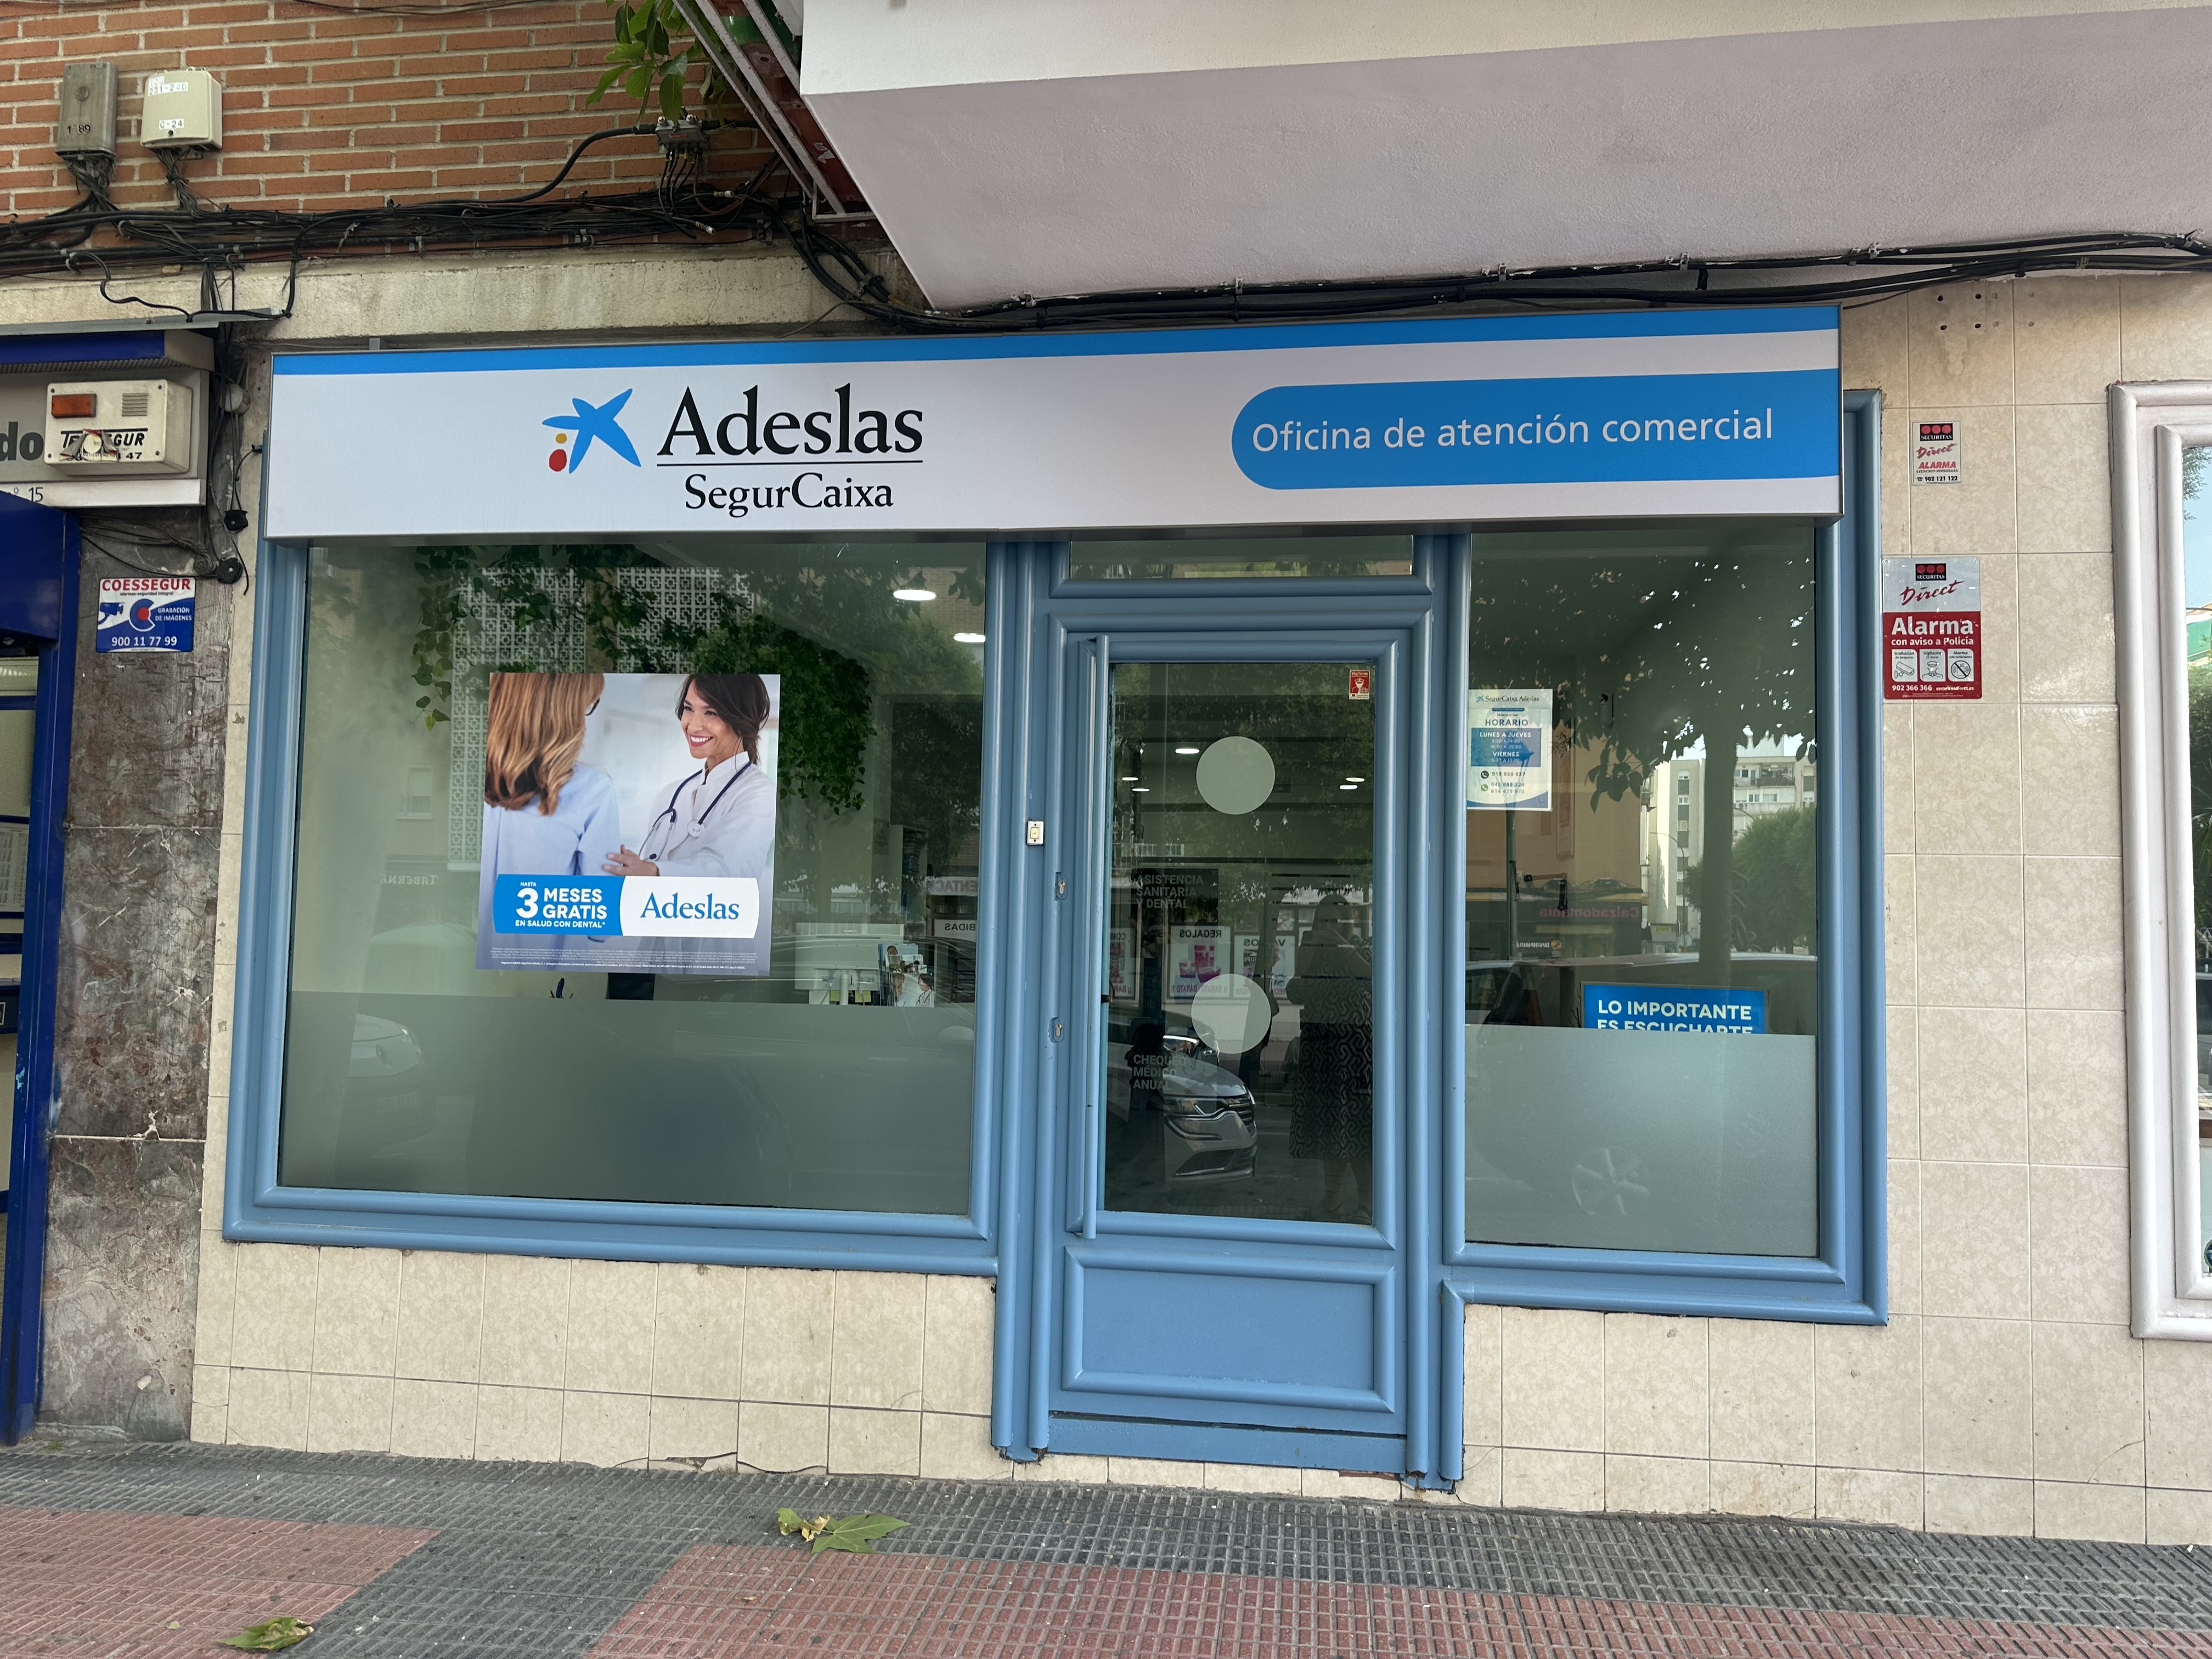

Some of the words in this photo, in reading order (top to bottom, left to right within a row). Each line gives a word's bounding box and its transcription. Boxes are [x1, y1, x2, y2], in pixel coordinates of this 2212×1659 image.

[657, 382, 923, 455] Adeslas
[1252, 420, 1370, 453] Oficina
[1383, 417, 1425, 449] de
[1437, 414, 1588, 447] atención
[1602, 408, 1773, 443] comercial
[0, 421, 44, 461] do
[1916, 443, 1957, 459] Direct
[29, 487, 43, 502] 15
[685, 472, 894, 517] SegurCaixa
[102, 578, 191, 591] COESSEGUR
[1899, 580, 1965, 606] Direct
[1891, 616, 1973, 635] Alarma
[111, 636, 130, 646] 900
[134, 636, 145, 646] 11
[149, 636, 161, 646] 77
[165, 636, 177, 646] 99
[1910, 637, 1933, 646] aviso
[1943, 636, 1973, 645] Policía
[1137, 874, 1204, 885] ASISTENCIA
[544, 888, 602, 903] MESES
[1136, 887, 1197, 896] SANITARIA
[516, 888, 538, 918] 3
[640, 892, 739, 920] Adeslas
[1136, 899, 1143, 908] Y
[1146, 899, 1190, 909] DENTAL
[543, 904, 607, 920] GRATIS
[1598, 1000, 1622, 1014] LO
[1628, 1001, 1752, 1020] IMPORTANTE
[1598, 1019, 1619, 1030] ES
[1133, 1054, 1186, 1066] CHEQUEO
[1133, 1065, 1177, 1077] MÉDICO
[1133, 1079, 1172, 1090] ANUAL
